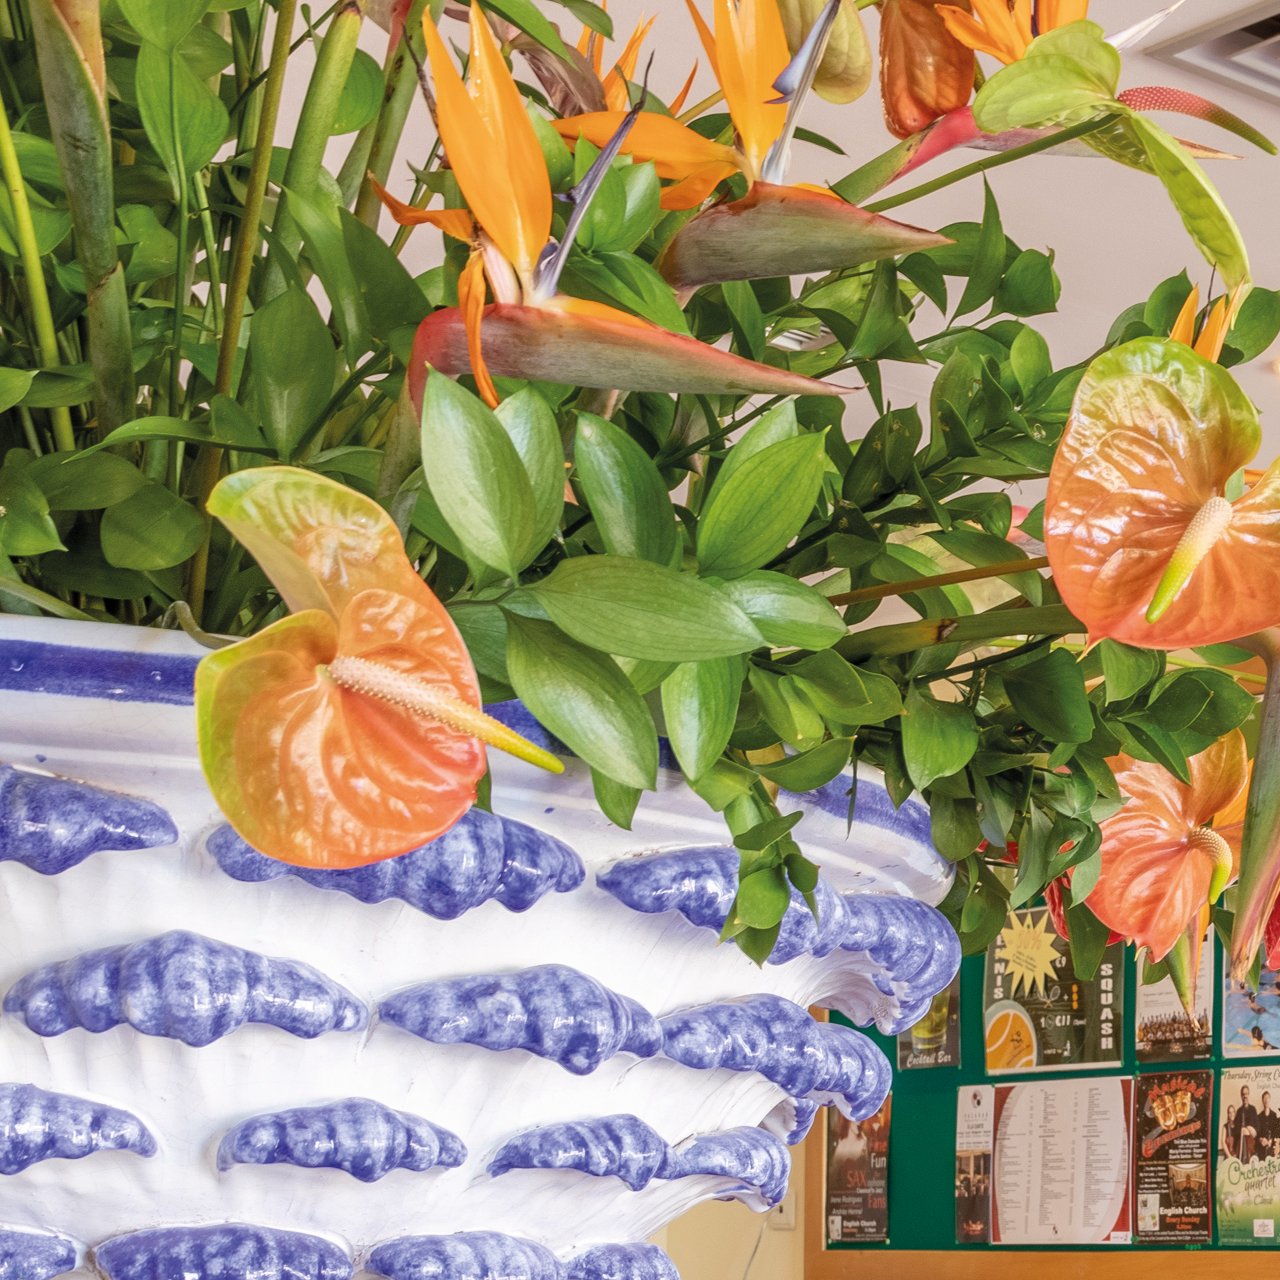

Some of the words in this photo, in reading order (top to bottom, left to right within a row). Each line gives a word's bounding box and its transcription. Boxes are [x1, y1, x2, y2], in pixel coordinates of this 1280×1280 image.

[1100, 964, 1114, 1049] SQUASH
[906, 1052, 936, 1068] Cocktail
[937, 1051, 952, 1064] Bar
[1224, 1070, 1252, 1080] Thursday
[1251, 1068, 1272, 1081] String
[870, 1153, 887, 1168] Fun
[1245, 1175, 1276, 1196] quartet
[1160, 1207, 1183, 1216] English
[1184, 1206, 1208, 1214] Church
